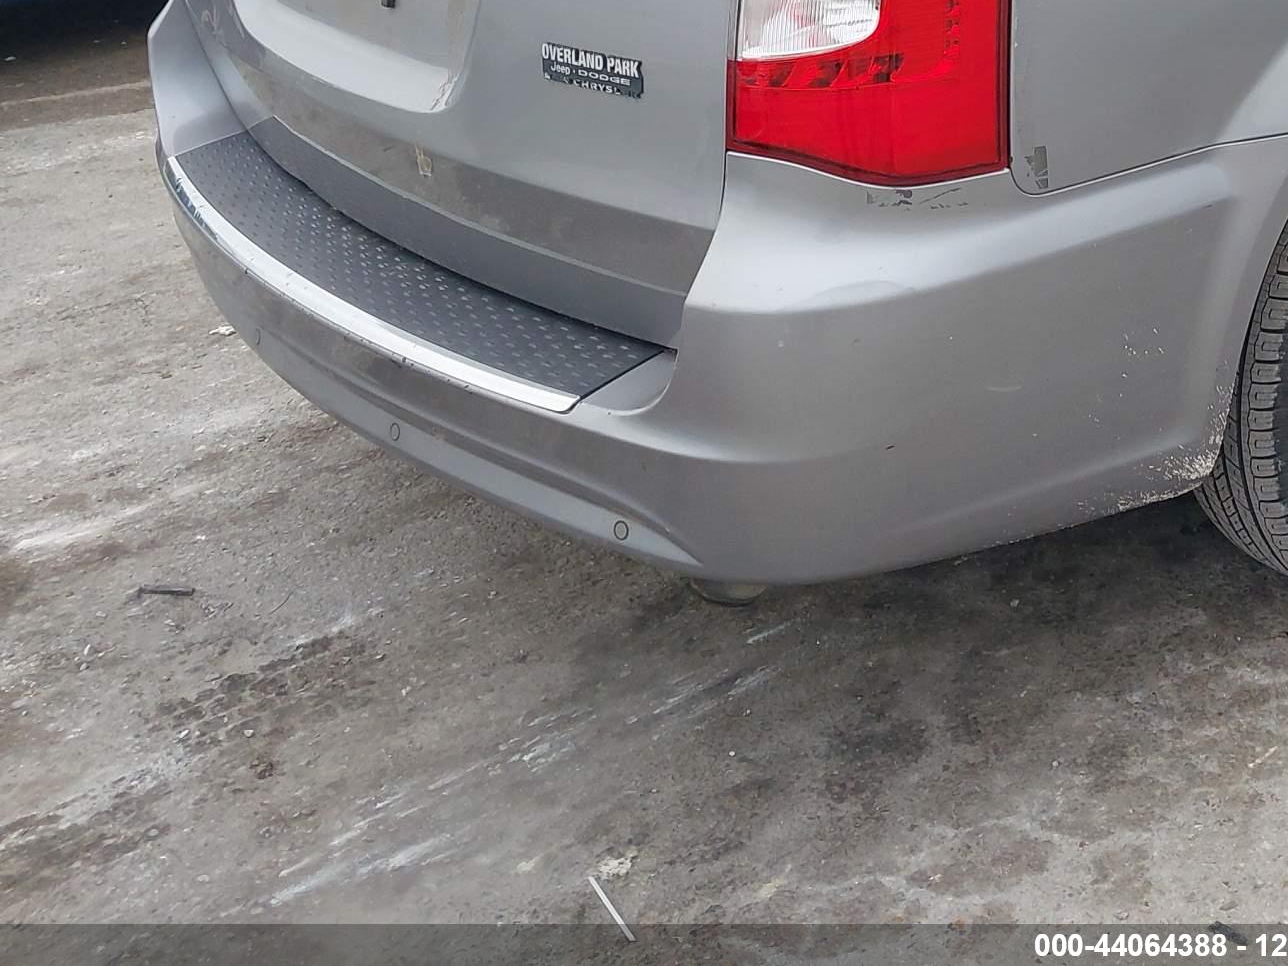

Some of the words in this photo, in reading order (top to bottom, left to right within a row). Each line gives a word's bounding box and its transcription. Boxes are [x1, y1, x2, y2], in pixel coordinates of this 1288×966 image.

[542, 43, 603, 70] OVERLAND
[607, 57, 639, 78] PARK
[550, 61, 571, 76] Jeep
[578, 69, 632, 86] DODGE
